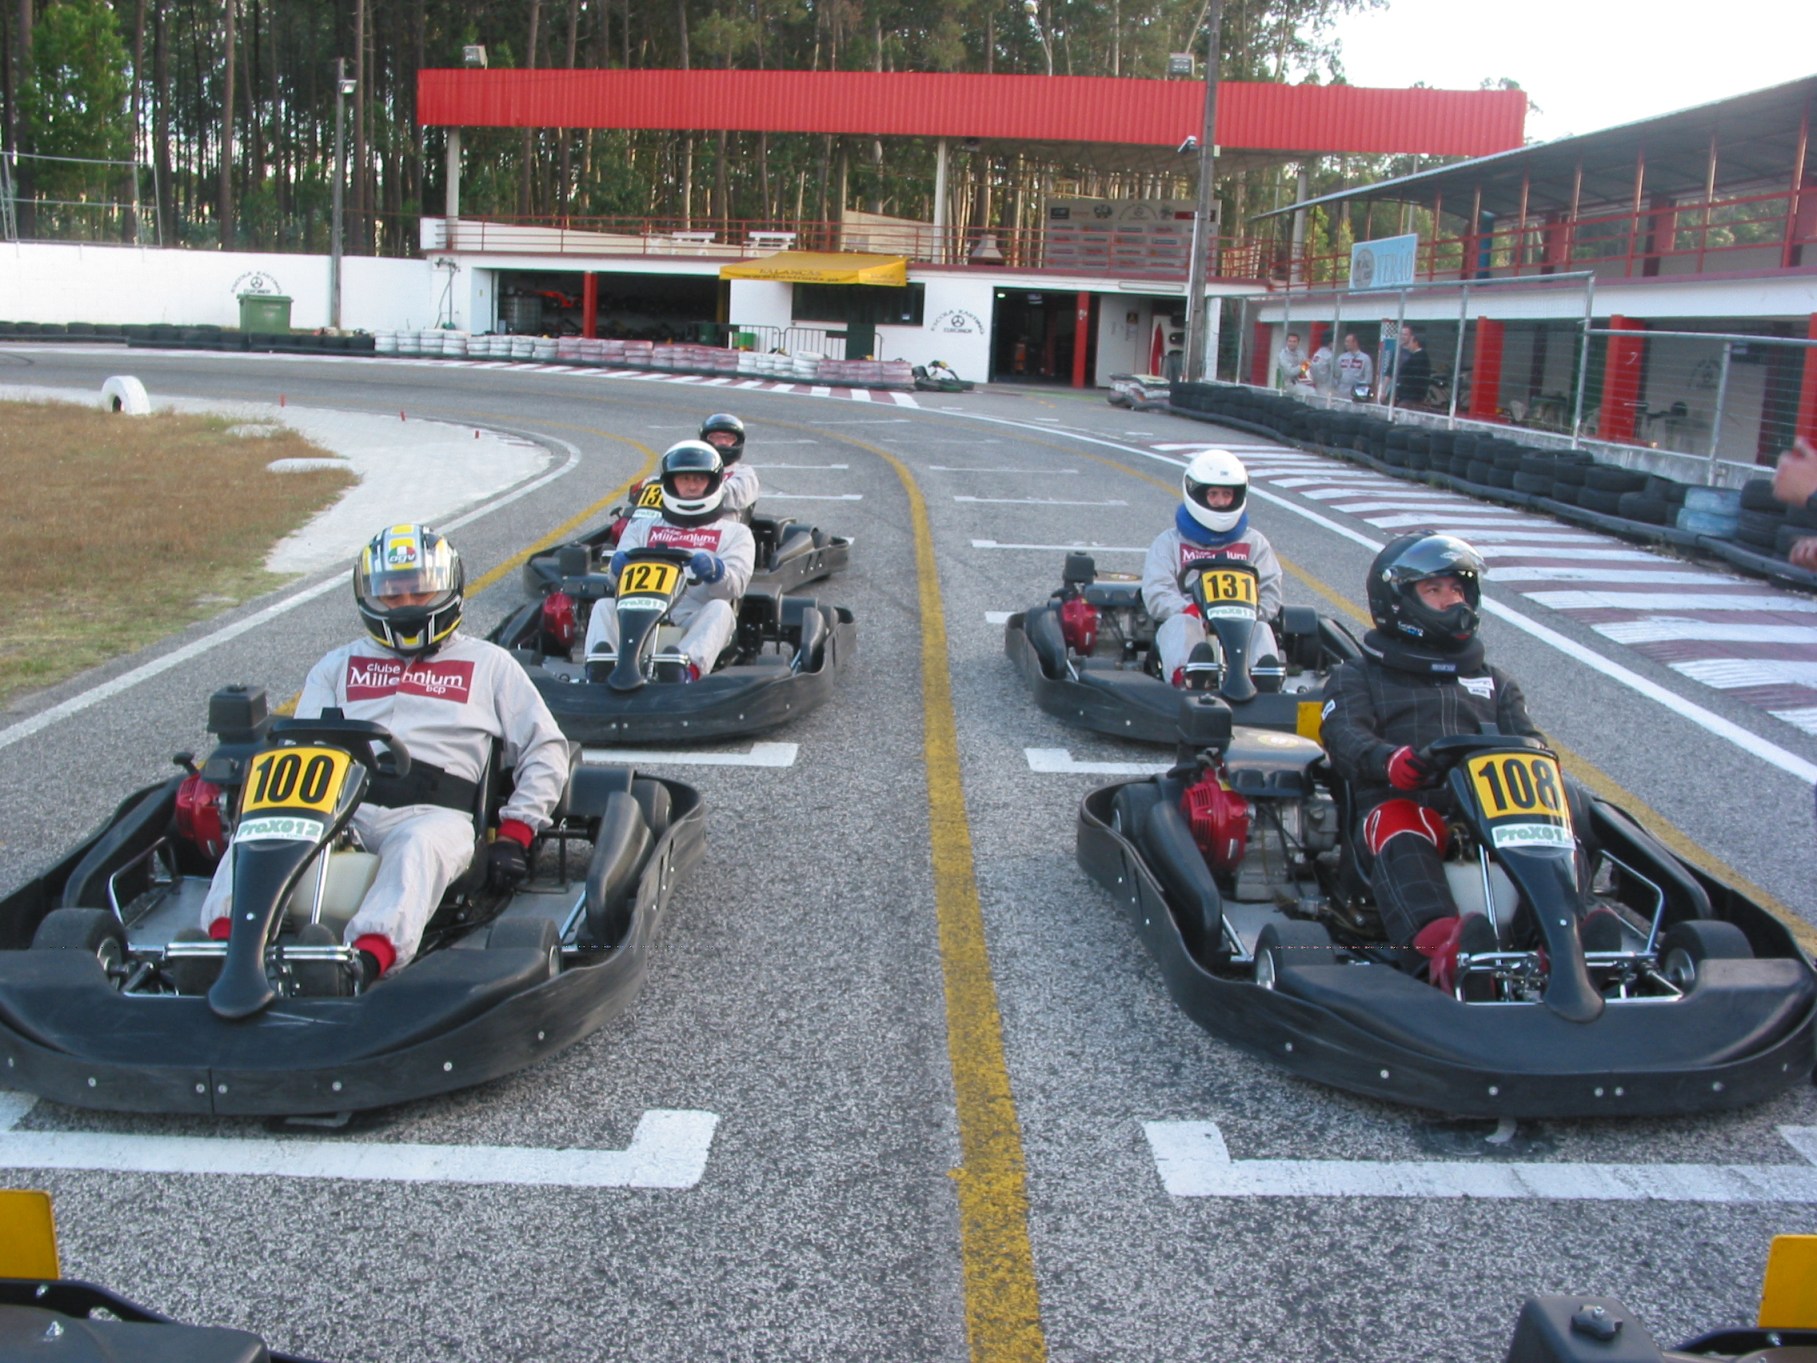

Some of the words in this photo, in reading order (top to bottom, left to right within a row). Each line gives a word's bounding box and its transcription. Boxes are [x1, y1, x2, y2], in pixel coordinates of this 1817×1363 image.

[624, 565, 668, 592] 127
[1207, 574, 1251, 600] 131
[366, 662, 401, 673] clube
[425, 684, 447, 695] bcp
[253, 753, 335, 804] 100
[1478, 758, 1560, 811] 108
